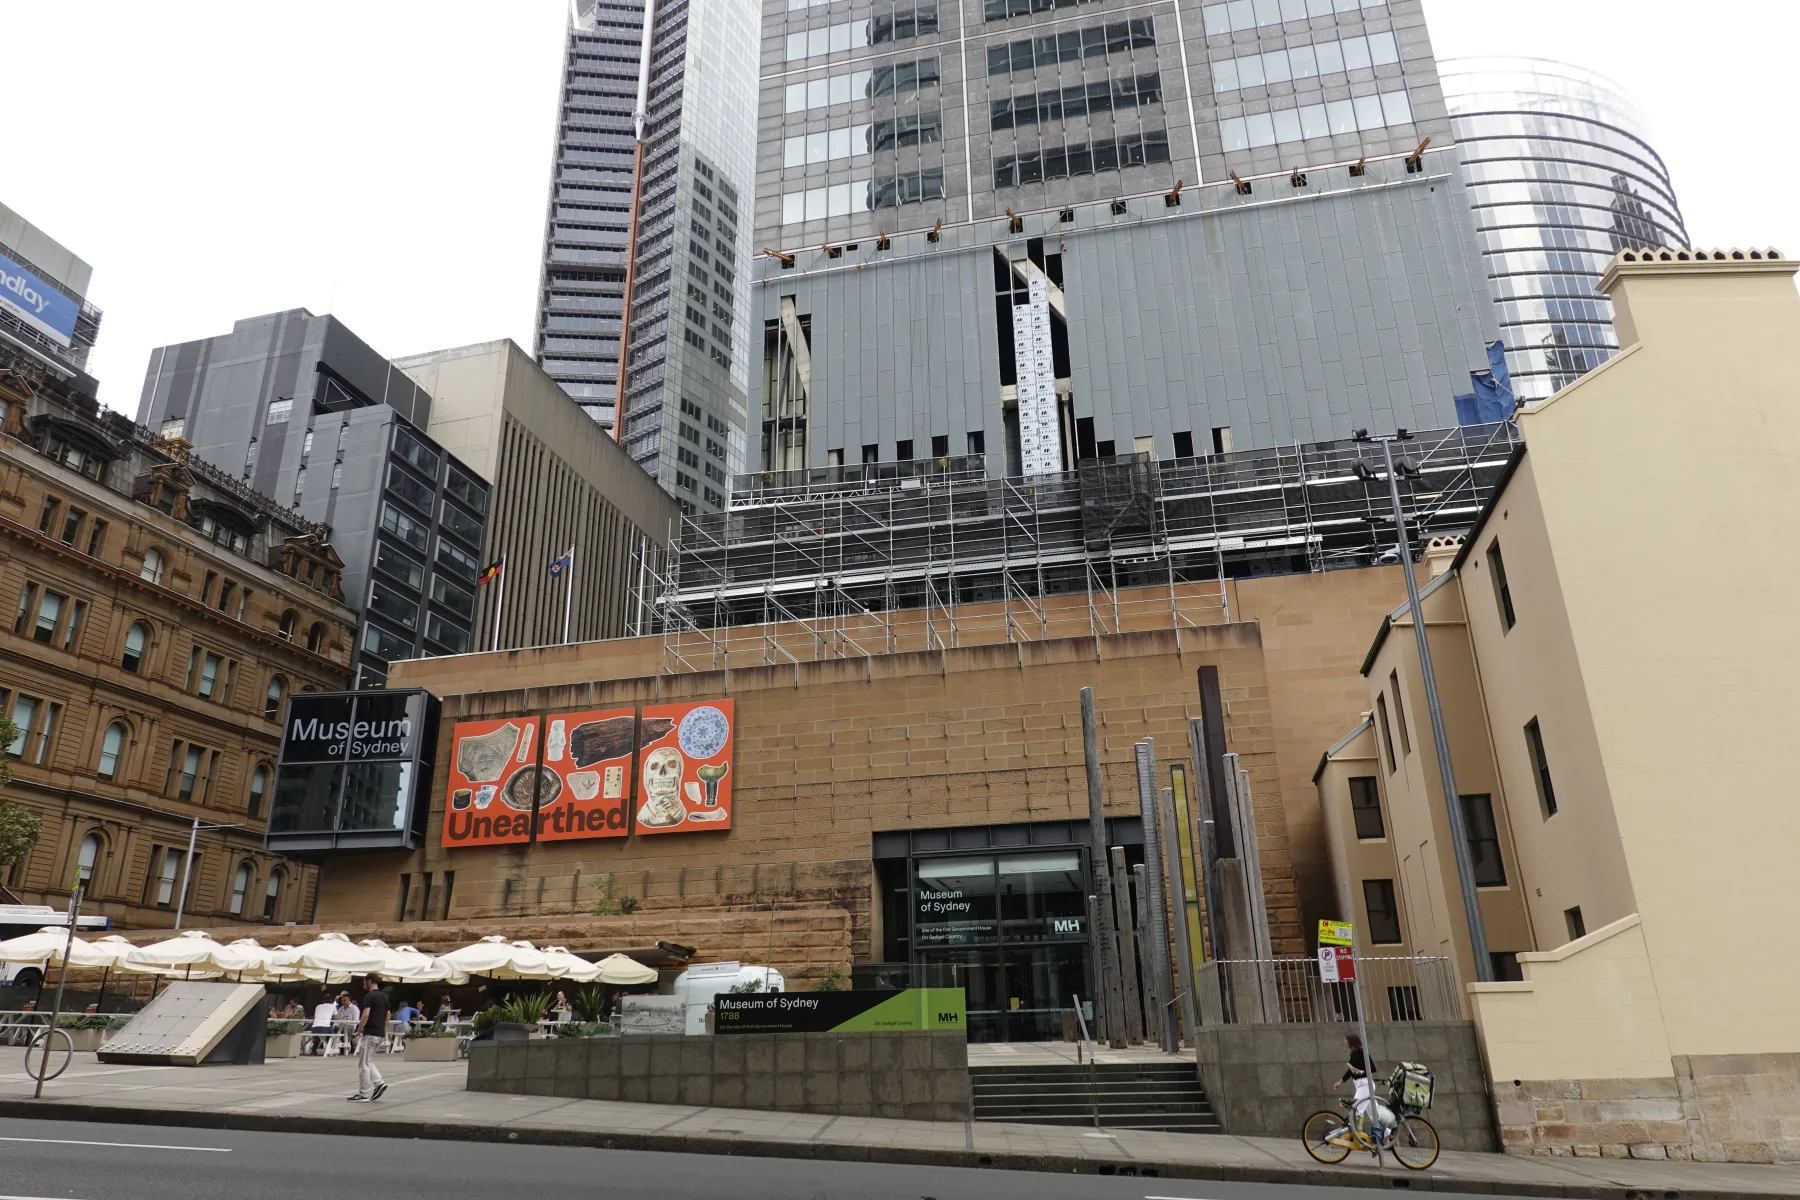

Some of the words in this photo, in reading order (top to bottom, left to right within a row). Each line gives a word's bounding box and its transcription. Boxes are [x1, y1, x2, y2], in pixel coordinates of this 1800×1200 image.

[291, 718, 411, 741] Museum
[328, 741, 346, 755] of
[351, 740, 409, 757] Sydney
[448, 799, 628, 841] Unearthed
[920, 890, 963, 900] Museum
[920, 902, 933, 912] of
[933, 899, 971, 913] Sydney
[1054, 919, 1080, 932] MH
[720, 1000, 764, 1009] Museum
[766, 998, 778, 1009] of
[780, 998, 819, 1010] Sydney
[720, 1011, 740, 1020] 1788
[938, 1012, 958, 1022] MH
